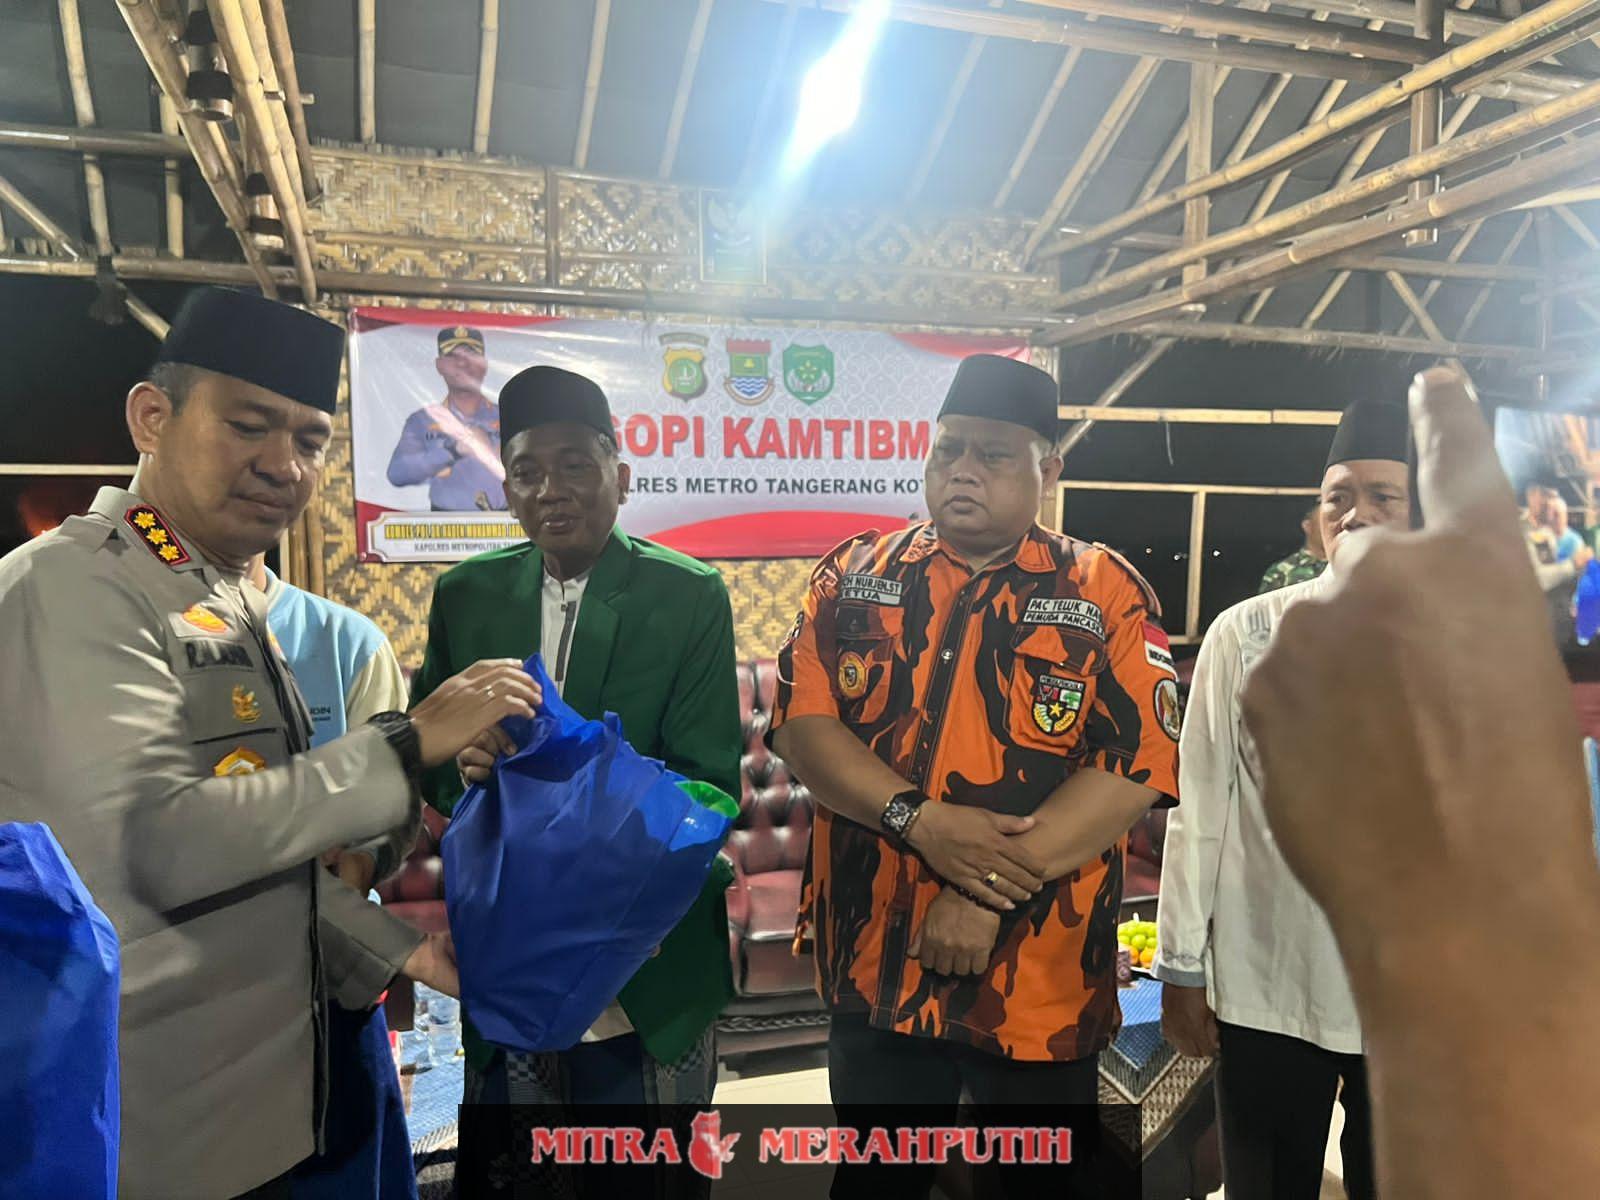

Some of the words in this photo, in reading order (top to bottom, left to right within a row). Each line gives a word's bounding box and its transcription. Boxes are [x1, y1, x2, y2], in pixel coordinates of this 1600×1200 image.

[723, 416, 930, 460] KAMTIBM
[630, 477, 677, 493] RES
[686, 477, 758, 494] METRO
[765, 478, 887, 494] TANGERANG
[894, 479, 923, 494] KO
[1030, 599, 1050, 611] PAC
[1026, 612, 1059, 622] PEMUDA
